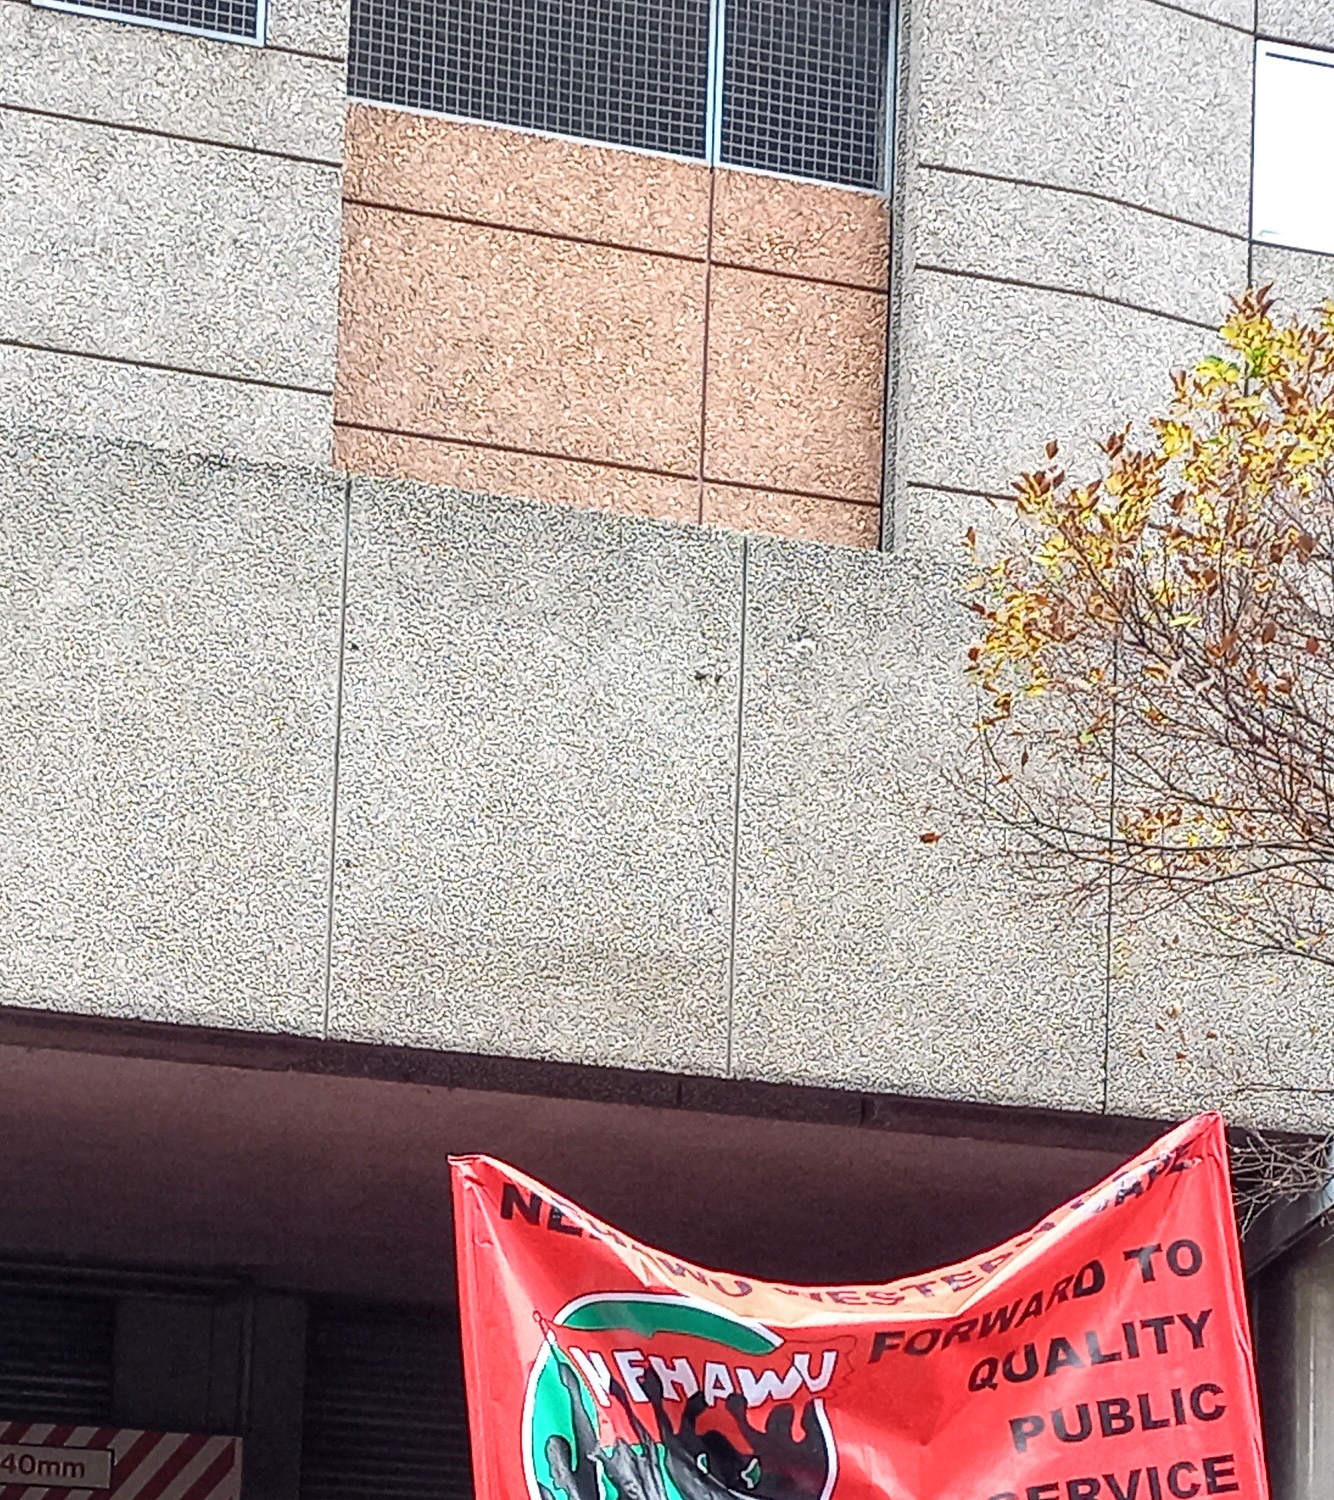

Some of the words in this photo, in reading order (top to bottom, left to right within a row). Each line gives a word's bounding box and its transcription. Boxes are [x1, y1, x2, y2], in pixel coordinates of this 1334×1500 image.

[867, 1259, 1106, 1364] FORWARD
[1123, 1239, 1203, 1283] TO
[968, 1308, 1213, 1392] QUALITY
[1009, 1383, 1227, 1453] PUBLIC
